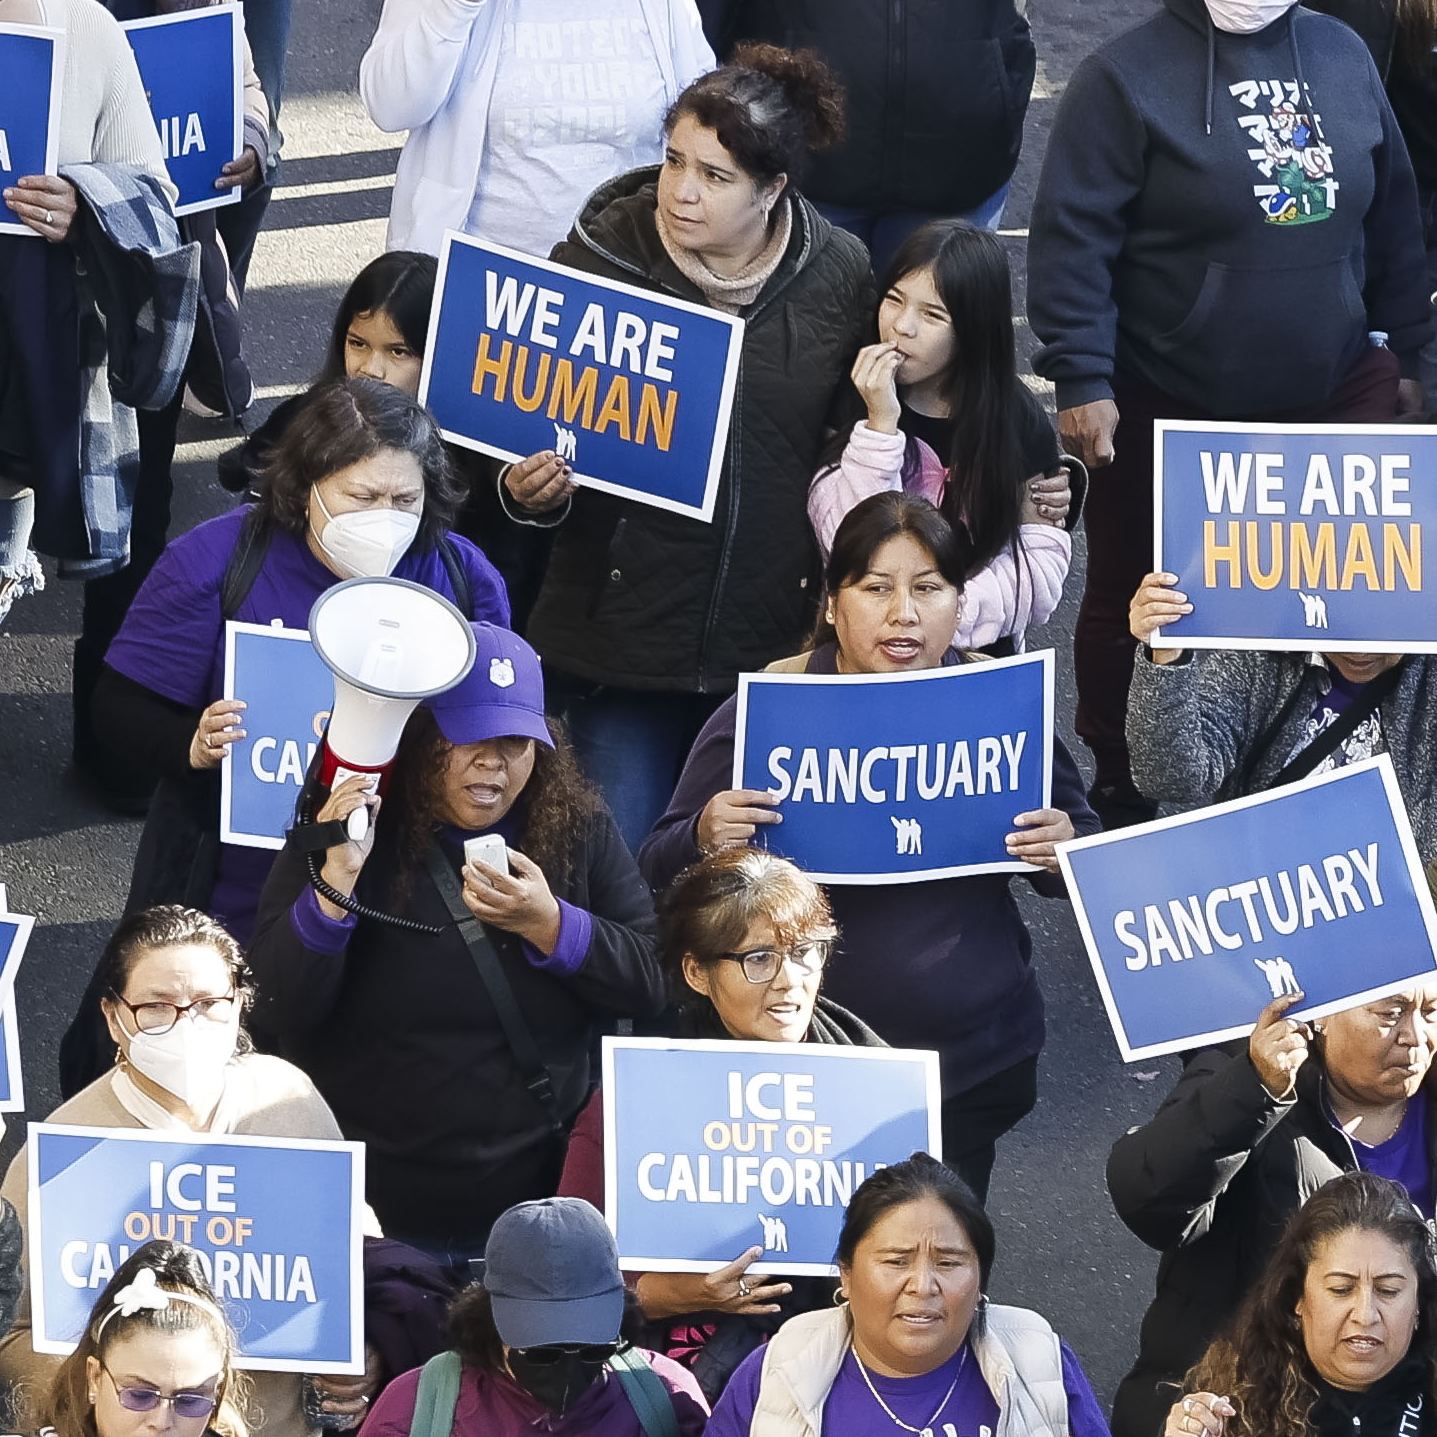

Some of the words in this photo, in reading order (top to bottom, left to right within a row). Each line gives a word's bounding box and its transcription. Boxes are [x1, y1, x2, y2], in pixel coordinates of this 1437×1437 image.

[485, 269, 564, 350] WE
[568, 303, 680, 383] ARE
[471, 334, 677, 452] HUMAN
[1200, 452, 1286, 516] WE
[1298, 454, 1411, 517] ARE
[1203, 520, 1422, 593] HUMAN
[766, 731, 1026, 805] SANCTUARY
[1114, 843, 1384, 973] SANCTUARY
[729, 1072, 816, 1122] ICE
[704, 1122, 776, 1153] OUT
[785, 1123, 833, 1155] OF
[150, 1161, 237, 1212] ICE
[637, 1153, 889, 1208] CALIFORNI
[123, 1211, 195, 1245] OUT
[205, 1213, 253, 1247] OF
[60, 1241, 316, 1305] CARNIA
